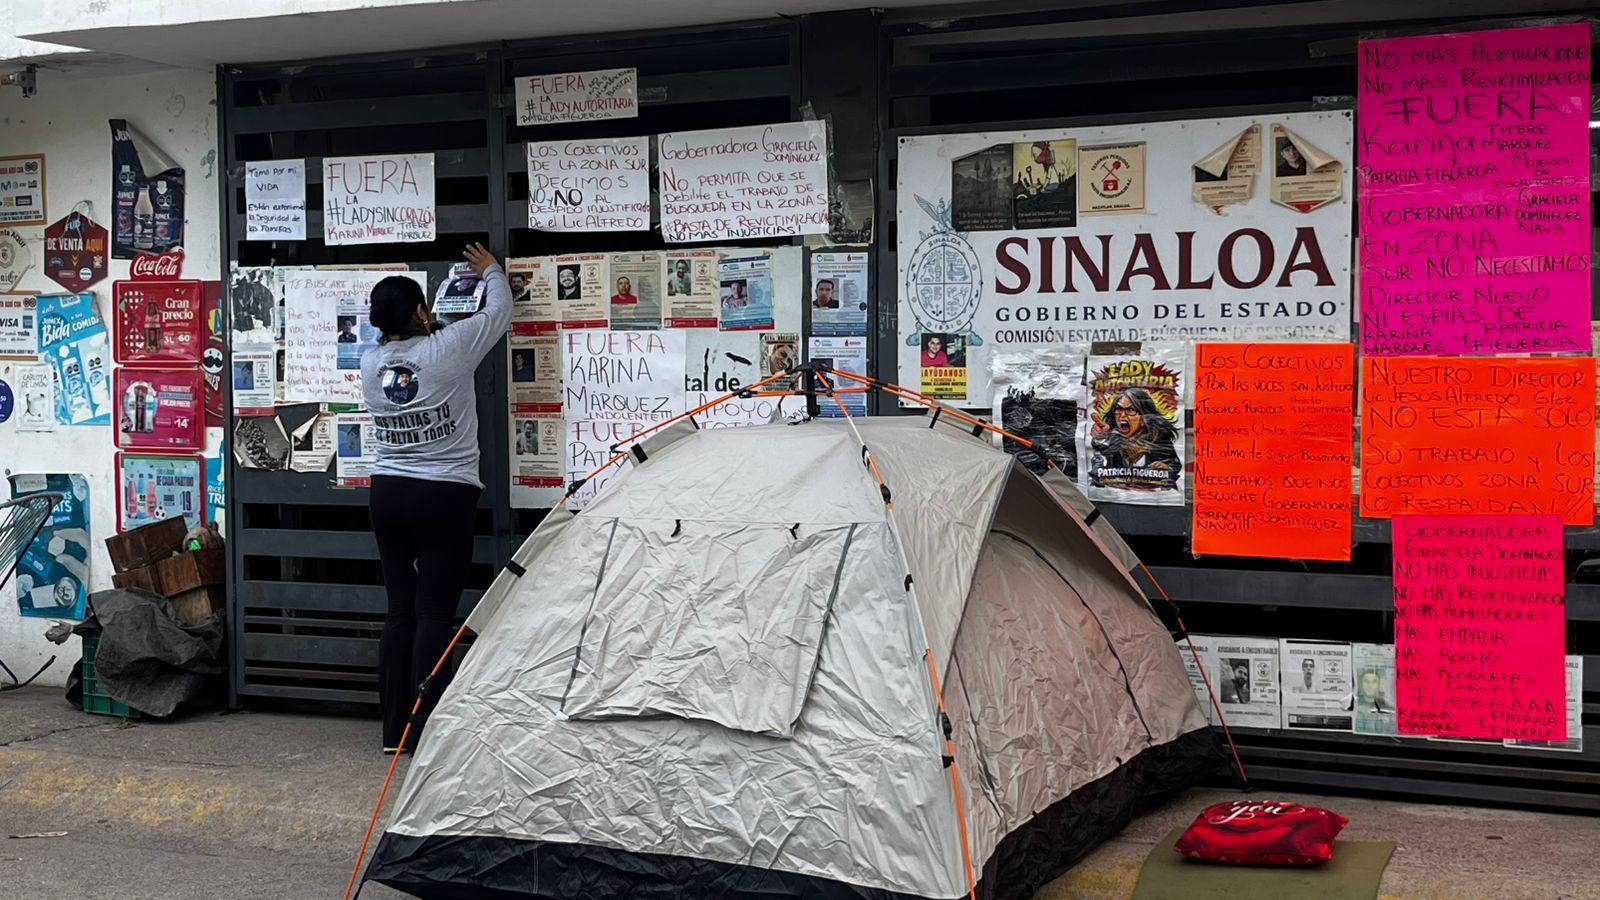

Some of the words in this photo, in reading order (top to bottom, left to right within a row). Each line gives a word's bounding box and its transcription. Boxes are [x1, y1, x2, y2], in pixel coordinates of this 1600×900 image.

[530, 75, 586, 94] FUERA
[1381, 89, 1566, 125] FUERA
[762, 127, 818, 152] GRACIELA
[529, 144, 558, 159] LOS
[564, 142, 640, 156] COLECTIVOS
[532, 160, 551, 172] DE
[559, 159, 578, 171] LA
[580, 159, 620, 171] ZONA
[623, 158, 650, 173] SUR
[1361, 164, 1419, 185] PATRICIA
[256, 183, 279, 192] VIDA
[327, 160, 419, 196] FUERA
[535, 173, 629, 190] DECIMOS
[697, 171, 750, 187] PERMITA
[757, 170, 786, 183] QUE
[790, 171, 807, 181] SE
[346, 195, 359, 206] LA
[529, 188, 546, 204] NO
[554, 188, 583, 207] NO
[716, 189, 734, 199] EL
[736, 186, 789, 197] TRABAJO
[795, 183, 814, 193] DE
[530, 204, 583, 214] DESPIDO
[665, 201, 727, 215] BUSQUEDA
[731, 200, 752, 212] EN
[757, 199, 773, 209] LA
[778, 198, 815, 209] ZONA
[1367, 196, 1510, 226] GOBERNADORA
[327, 227, 366, 241] KARINA
[715, 218, 731, 231] DE
[47, 238, 57, 250] DE
[59, 238, 84, 251] VENTA
[1363, 233, 1400, 257] EN
[1408, 228, 1499, 255] ZONA
[995, 226, 1337, 295] SINALOA
[1363, 257, 1415, 282] SUR
[1427, 254, 1465, 279] NO
[1475, 252, 1588, 277] NECESITAMOS
[165, 298, 190, 308] Gran
[1366, 285, 1461, 311] DIRECTOR
[1473, 283, 1551, 305] NUEVO
[162, 309, 194, 323] precio
[995, 304, 1139, 322] GOBIERNO
[1154, 303, 1206, 319] DEL
[1220, 301, 1338, 318] ESTADO
[1363, 311, 1388, 331] NI
[1498, 305, 1537, 322] DE
[42, 321, 71, 347] Bida
[995, 326, 1066, 344] COMISIÓN
[1068, 328, 1125, 343] ESTATAL
[1363, 328, 1434, 343] KARINA
[566, 333, 666, 356] FUERA
[1199, 343, 1239, 369] LOS
[1243, 343, 1345, 371] COLECTIVOS
[570, 356, 653, 388] KARINA
[1108, 360, 1154, 377] LADY
[1371, 358, 1473, 387] NUESTRO
[1488, 366, 1586, 389] DIRECTOR
[714, 372, 741, 392] de
[1254, 379, 1286, 393] VOCES
[566, 386, 670, 414] MÁRQUEZ
[699, 393, 773, 421] APOYO
[391, 412, 432, 429] FALTAS
[1369, 405, 1418, 430] NO
[1427, 406, 1524, 429] ESTA
[1534, 406, 1593, 429] SOLO
[385, 431, 420, 445] FALTAN
[423, 420, 457, 442] TODOS
[1366, 433, 1403, 466] SU
[1410, 446, 1516, 464] TRABAJO
[1556, 441, 1592, 468] LOS
[1097, 467, 1132, 478] PATRICIA
[1132, 467, 1170, 479] FIGUEROA
[1282, 474, 1314, 490] QUE
[1319, 478, 1349, 490] NOS
[1364, 467, 1464, 490] COLECTIVOS
[1478, 474, 1541, 489] ZONA
[1551, 473, 1595, 495] SUR
[1197, 489, 1259, 503] ESCUCHE
[1362, 491, 1392, 512] LO
[1395, 560, 1421, 580] NO
